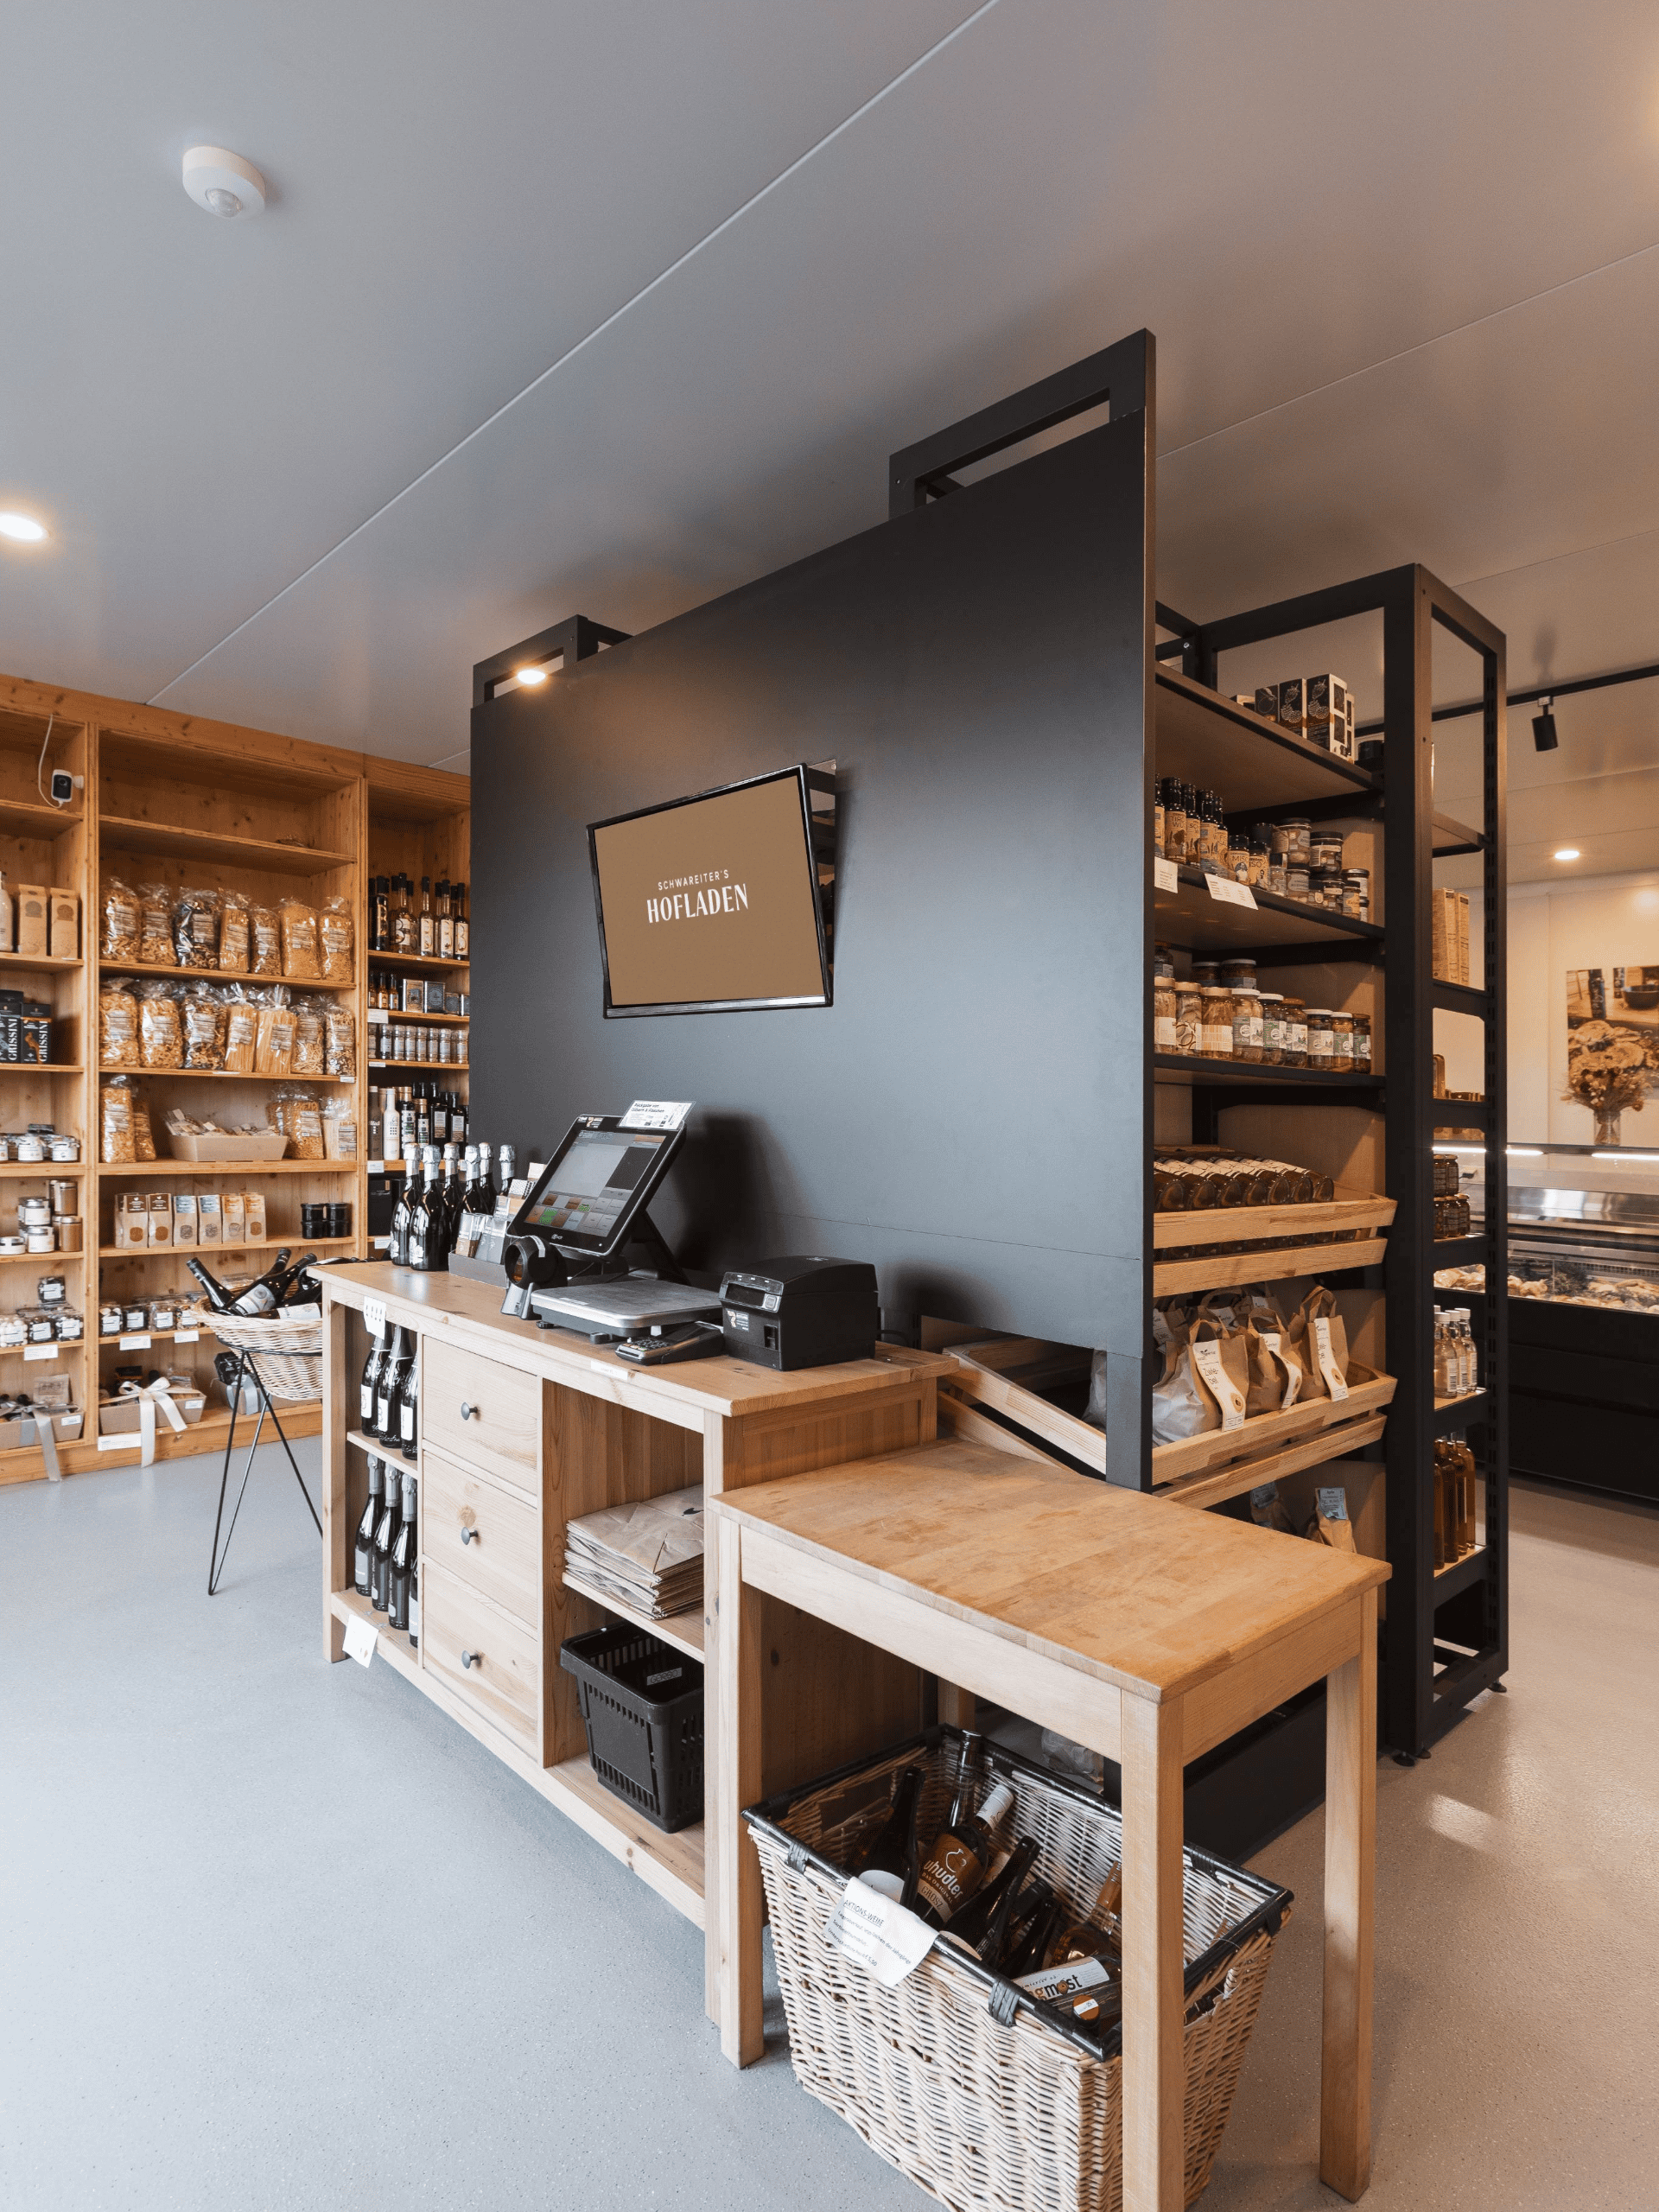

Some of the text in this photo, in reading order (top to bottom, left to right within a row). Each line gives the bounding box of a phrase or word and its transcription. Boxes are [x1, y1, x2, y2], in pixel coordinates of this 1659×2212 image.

[658, 869, 729, 891] SCHWAREITER'S
[647, 883, 748, 924] HOFLADEN
[8, 1019, 17, 1061] GRISSINI
[39, 1020, 48, 1062] GRISSINI
